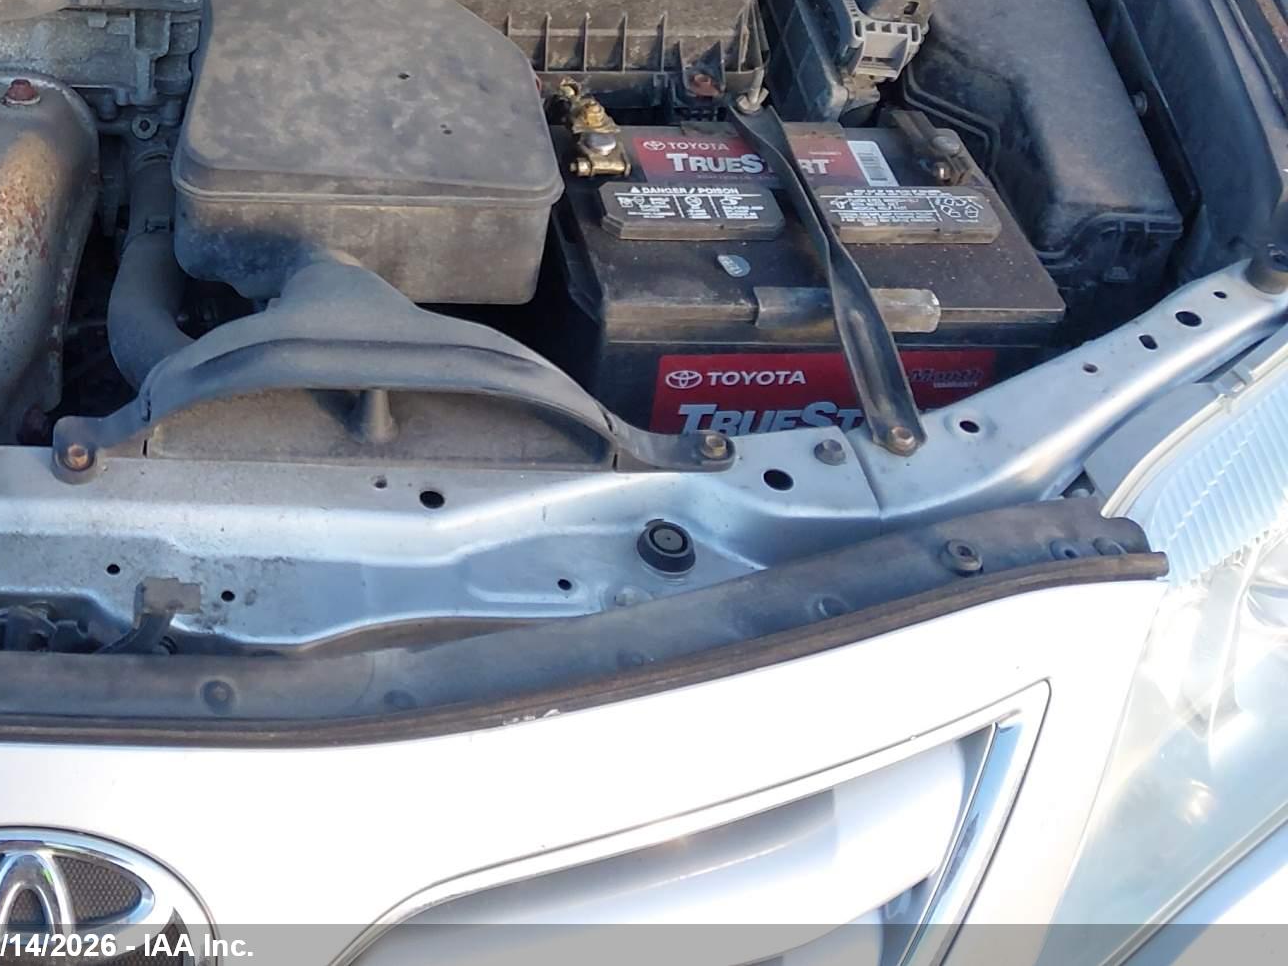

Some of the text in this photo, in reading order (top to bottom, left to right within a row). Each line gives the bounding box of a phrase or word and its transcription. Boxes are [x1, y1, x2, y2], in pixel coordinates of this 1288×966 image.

[667, 141, 730, 151] TOYOTA
[665, 153, 832, 175] TRUESRT
[641, 186, 688, 194] DANGER
[706, 370, 807, 386] TOYOTA
